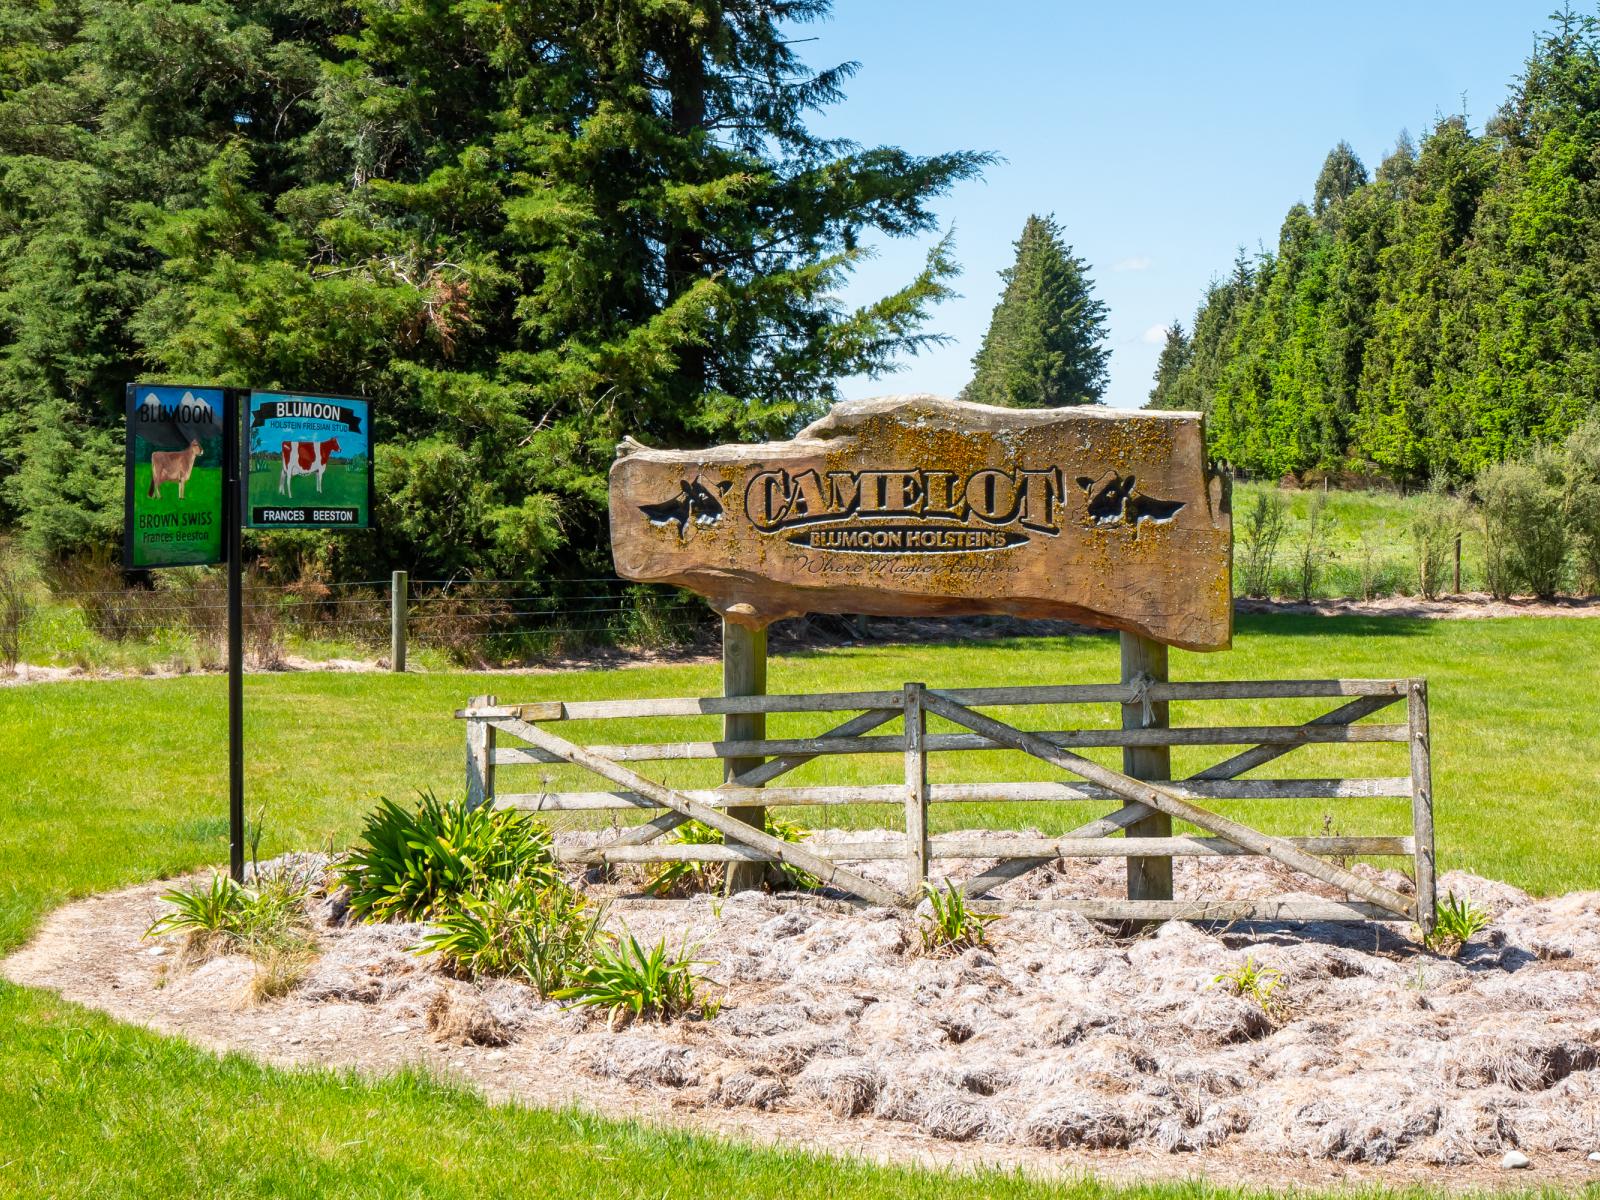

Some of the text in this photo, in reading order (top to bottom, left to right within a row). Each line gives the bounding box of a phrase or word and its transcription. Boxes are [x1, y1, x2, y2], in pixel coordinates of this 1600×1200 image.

[140, 403, 213, 424] BLUMOON
[276, 402, 341, 420] BLUMOON
[270, 420, 348, 432] HOLSTEIN FRIESIAN STUD
[745, 467, 1067, 535] CAMELOT
[139, 512, 212, 529] BROWN SWISS
[263, 510, 352, 521] FRANCES BEESTON
[143, 530, 209, 543] Frances Beeston
[810, 531, 1007, 548] BLUMOON HOLSTEINS
